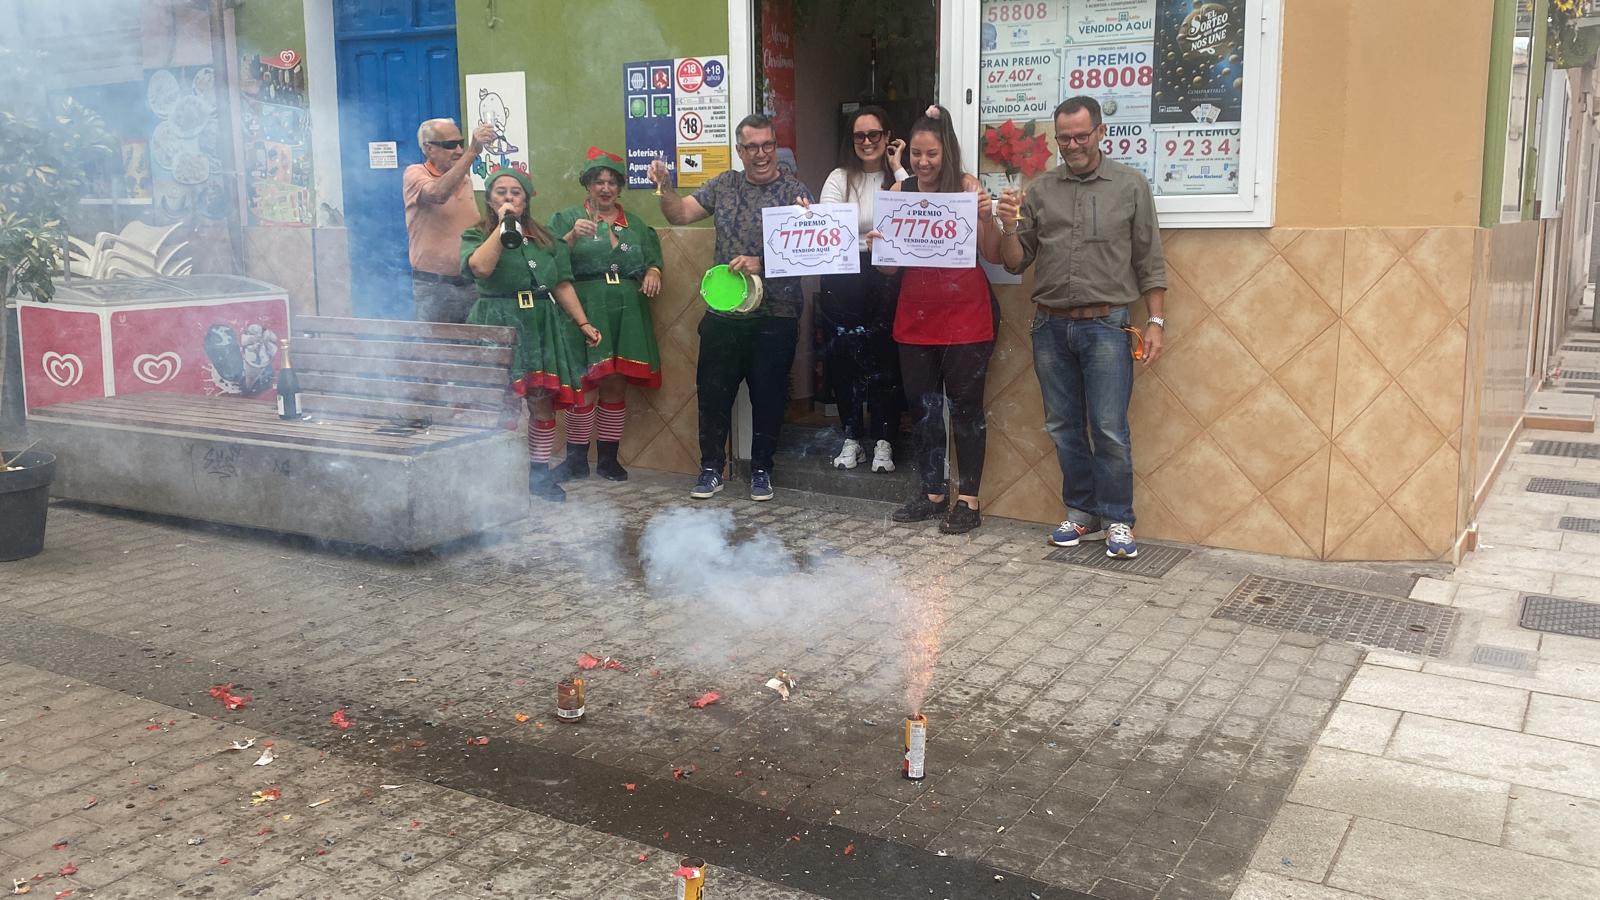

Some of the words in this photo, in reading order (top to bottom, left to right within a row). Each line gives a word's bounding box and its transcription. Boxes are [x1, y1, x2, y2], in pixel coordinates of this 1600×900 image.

[988, 2, 1047, 22] 58808
[1206, 10, 1217, 19] EL
[1079, 23, 1123, 34] VENDIDO
[1126, 18, 1152, 31] AQUÍ
[1188, 13, 1228, 36] SORTEO
[1191, 38, 1207, 51] NOS
[1208, 29, 1227, 44] UNE
[980, 58, 1009, 68] GRAN
[1012, 55, 1050, 66] PREMIO
[1088, 52, 1146, 66] PREMIO
[705, 65, 721, 75] +18
[988, 69, 1034, 83] 67.407
[1070, 66, 1153, 89] 88008
[981, 104, 1020, 114] VENDIDO
[1024, 101, 1047, 112] AQUÍ
[683, 118, 697, 133] -18
[1104, 125, 1142, 137] REMIO
[628, 148, 657, 157] Loterías
[659, 150, 664, 158] y
[1103, 138, 1147, 155] 393
[891, 219, 957, 239] 77768
[780, 228, 841, 249] 77768
